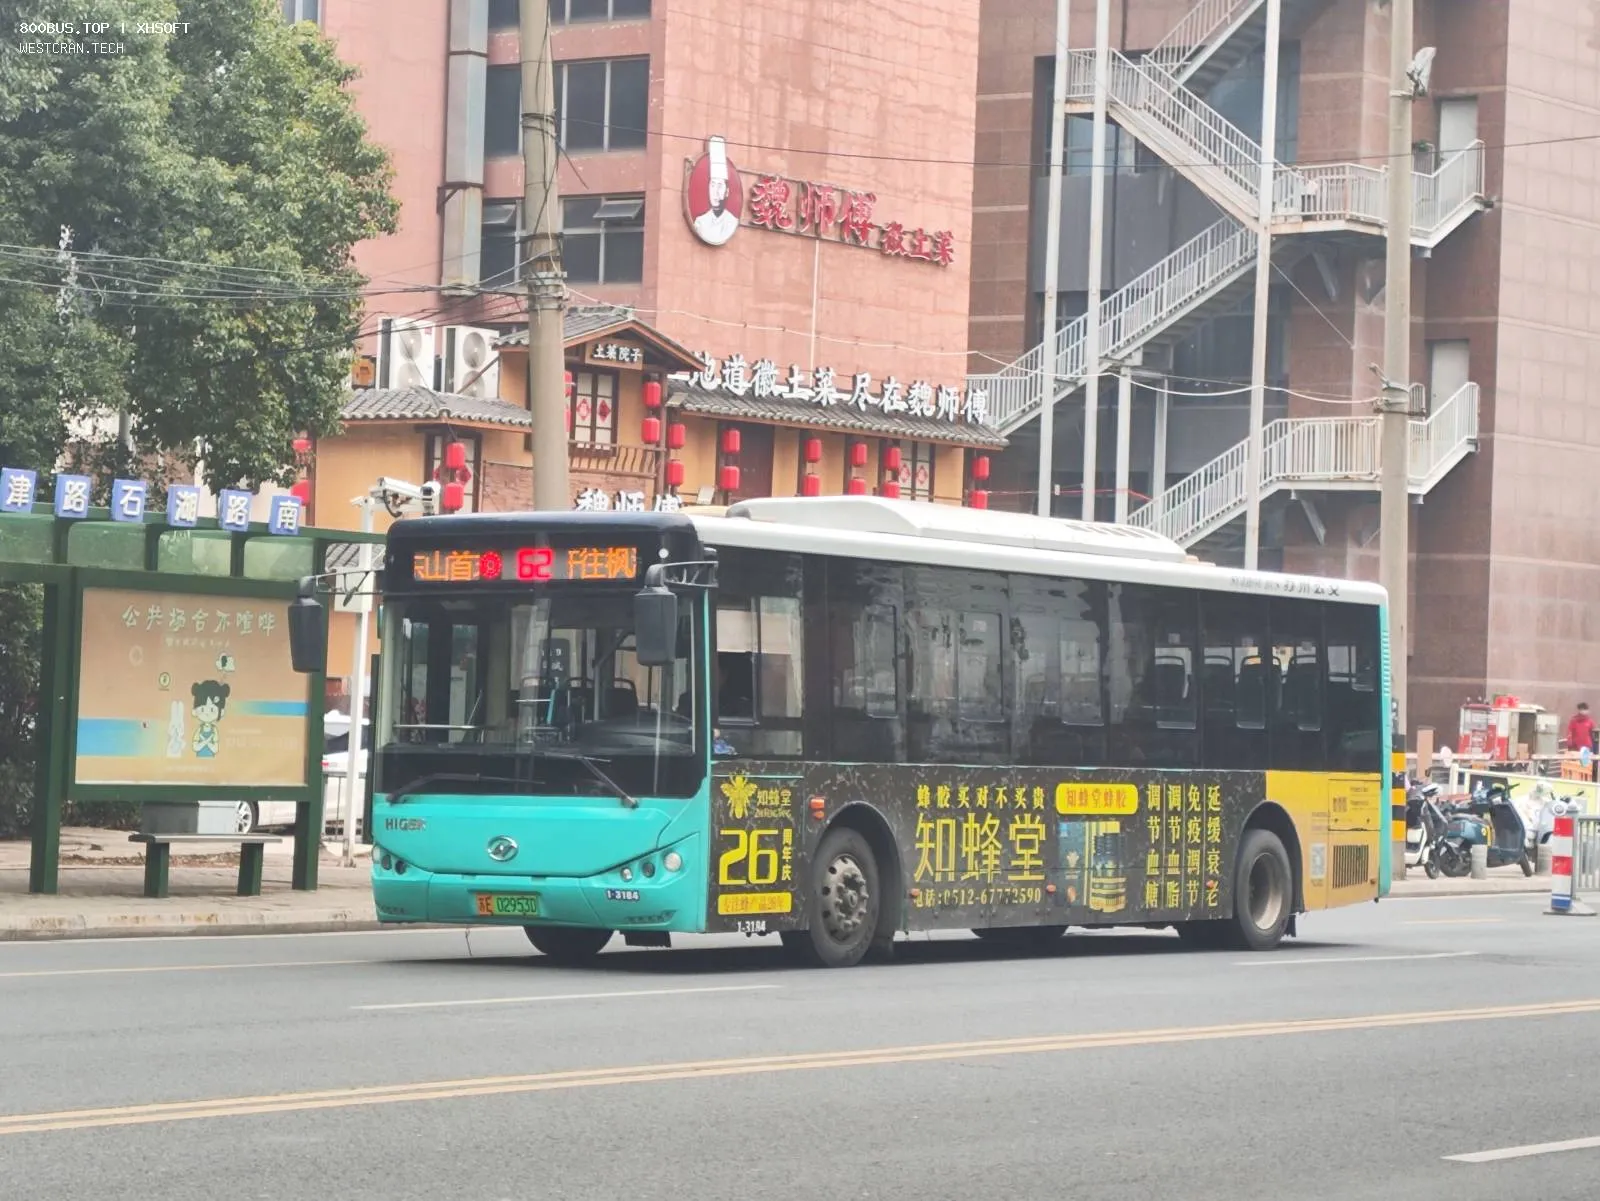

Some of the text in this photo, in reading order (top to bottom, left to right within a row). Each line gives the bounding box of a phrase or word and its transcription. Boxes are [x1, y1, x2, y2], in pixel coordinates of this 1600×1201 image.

[751, 174, 876, 246] 魏师傅
[592, 343, 643, 362] 土菜院子
[516, 548, 554, 581] 62
[916, 784, 1046, 810] 蜂胶买对不买贵
[719, 829, 778, 885] 26
[781, 829, 793, 881] 周年庆
[914, 812, 1046, 882] 知蜂堂
[1145, 784, 1161, 908] 调节血糖
[1166, 784, 1182, 907] 调节血脂
[1186, 784, 1202, 907] 免疫调节
[1206, 784, 1221, 908] 延缓衰老
